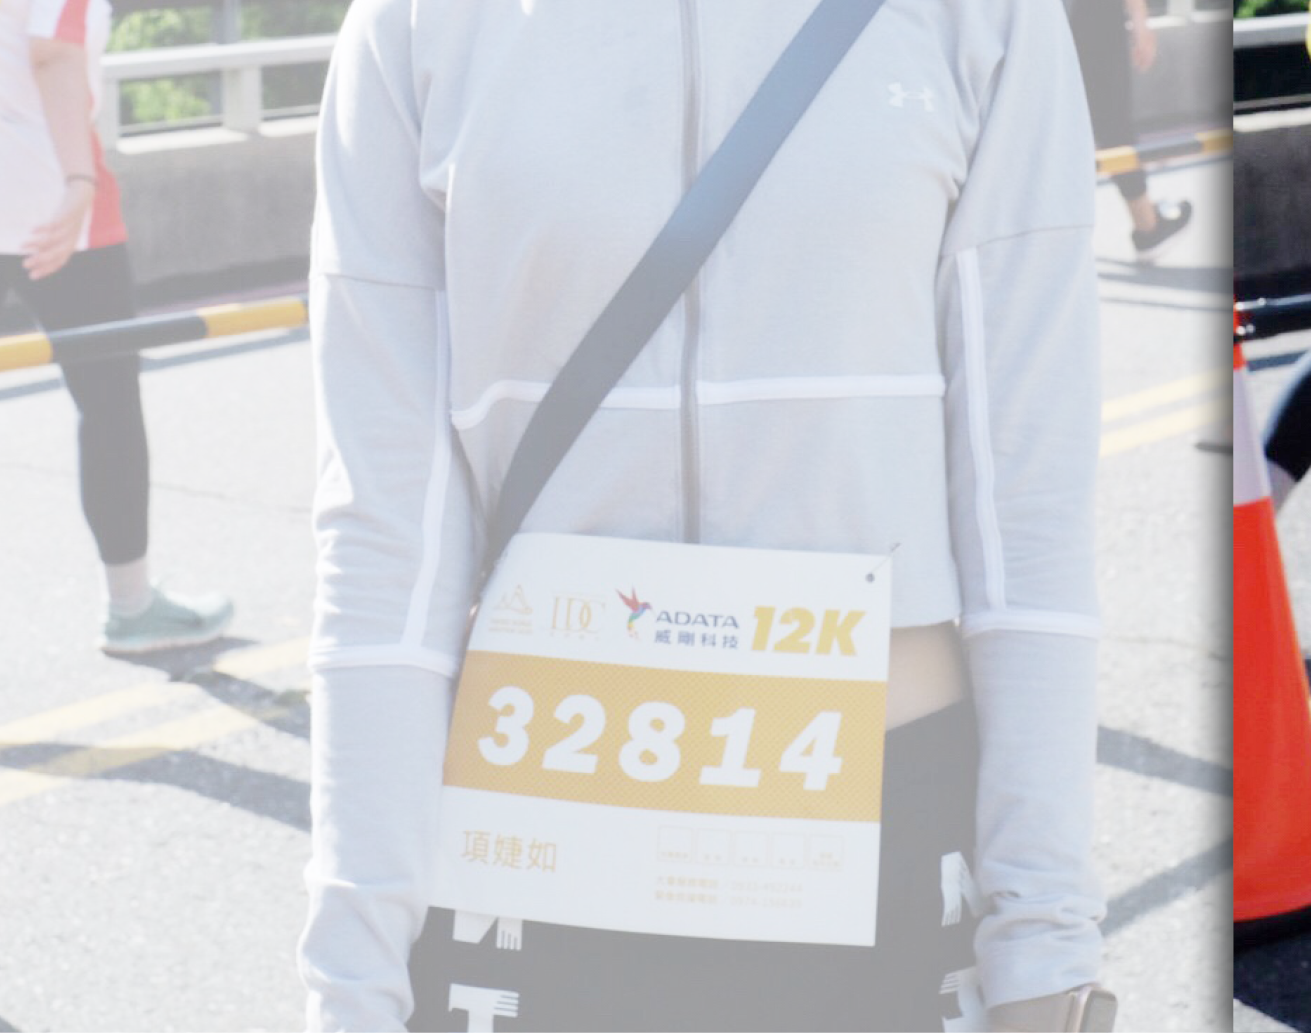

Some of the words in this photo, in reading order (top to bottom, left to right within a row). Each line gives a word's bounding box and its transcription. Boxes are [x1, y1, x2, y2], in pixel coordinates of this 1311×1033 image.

[654, 629, 738, 649] 威剛科技
[655, 610, 740, 630] ADATA
[750, 605, 866, 657] 12K
[477, 685, 842, 791] 32814
[460, 829, 557, 873] 項婕如
